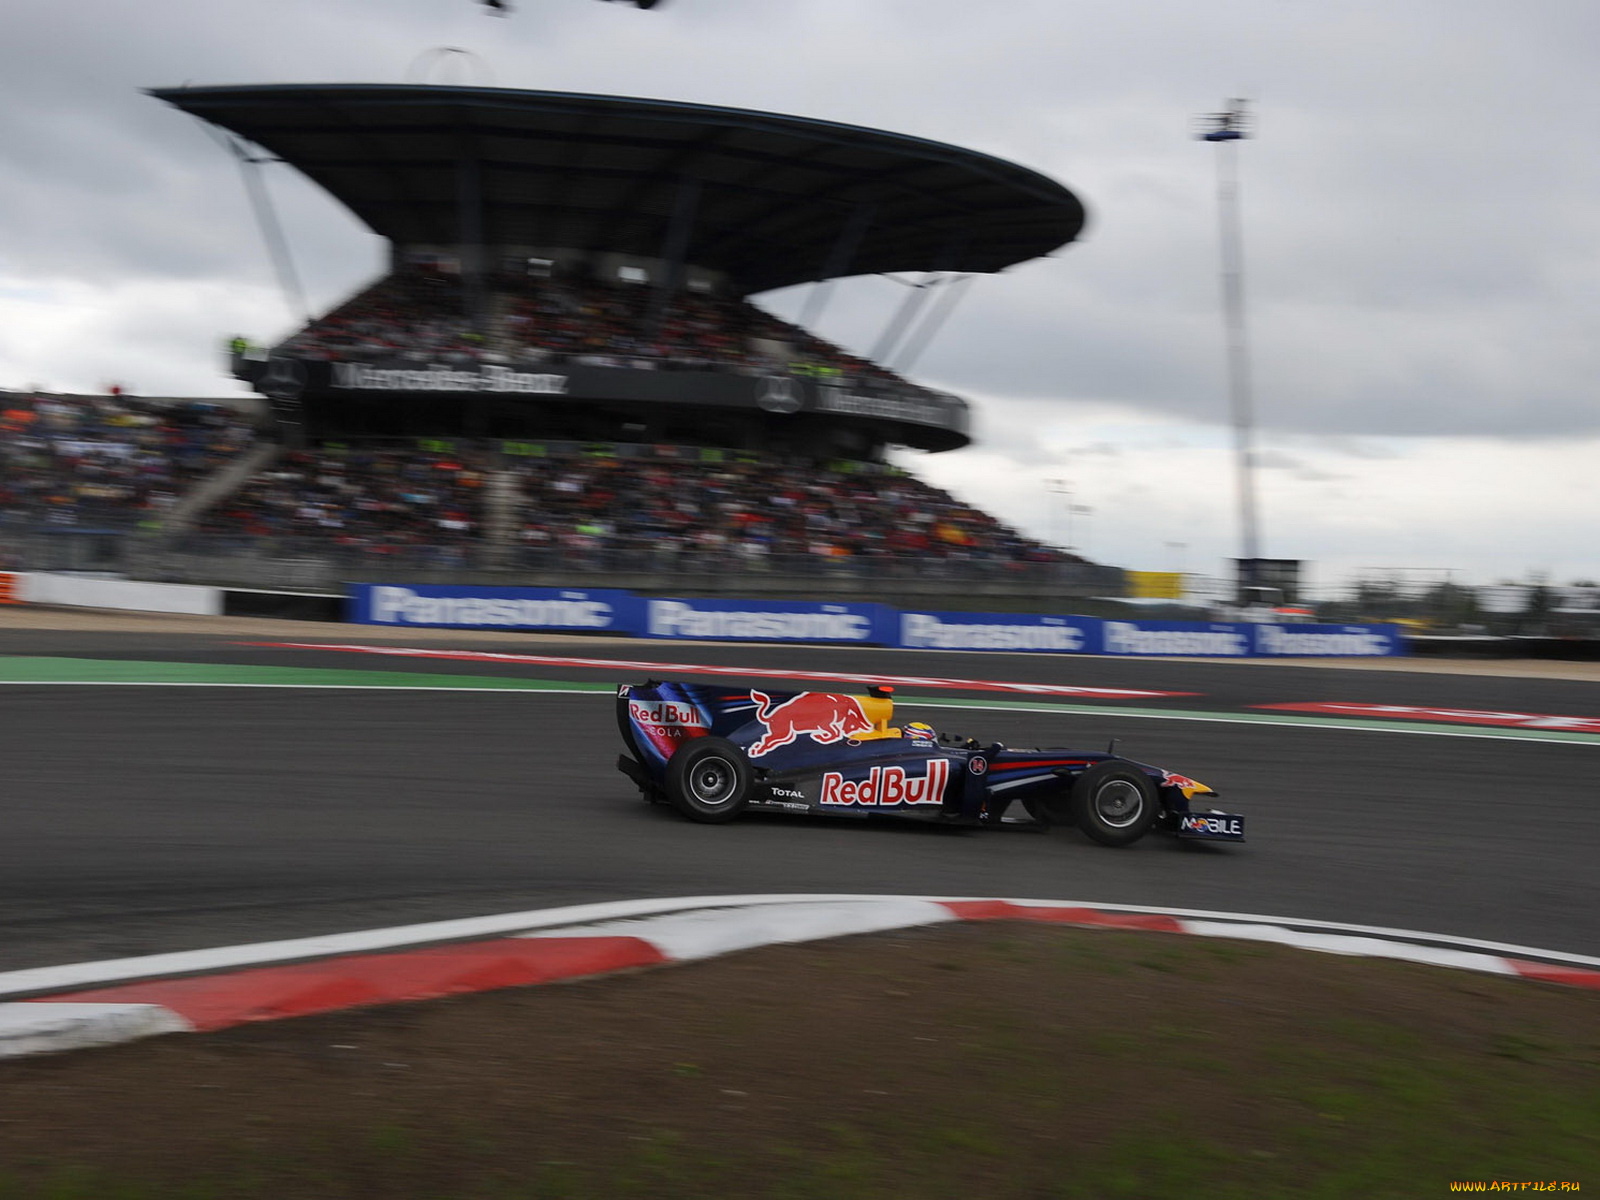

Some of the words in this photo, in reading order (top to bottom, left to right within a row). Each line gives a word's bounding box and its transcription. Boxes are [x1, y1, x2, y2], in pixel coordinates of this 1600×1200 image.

[371, 585, 613, 629] Panasonic
[649, 599, 870, 640] Panasonic
[901, 612, 1085, 650] Panasonic
[630, 704, 662, 722] Red
[665, 704, 701, 724] Bull
[771, 787, 805, 798] TOTAL
[821, 767, 880, 805] Red
[880, 760, 948, 805] Bull
